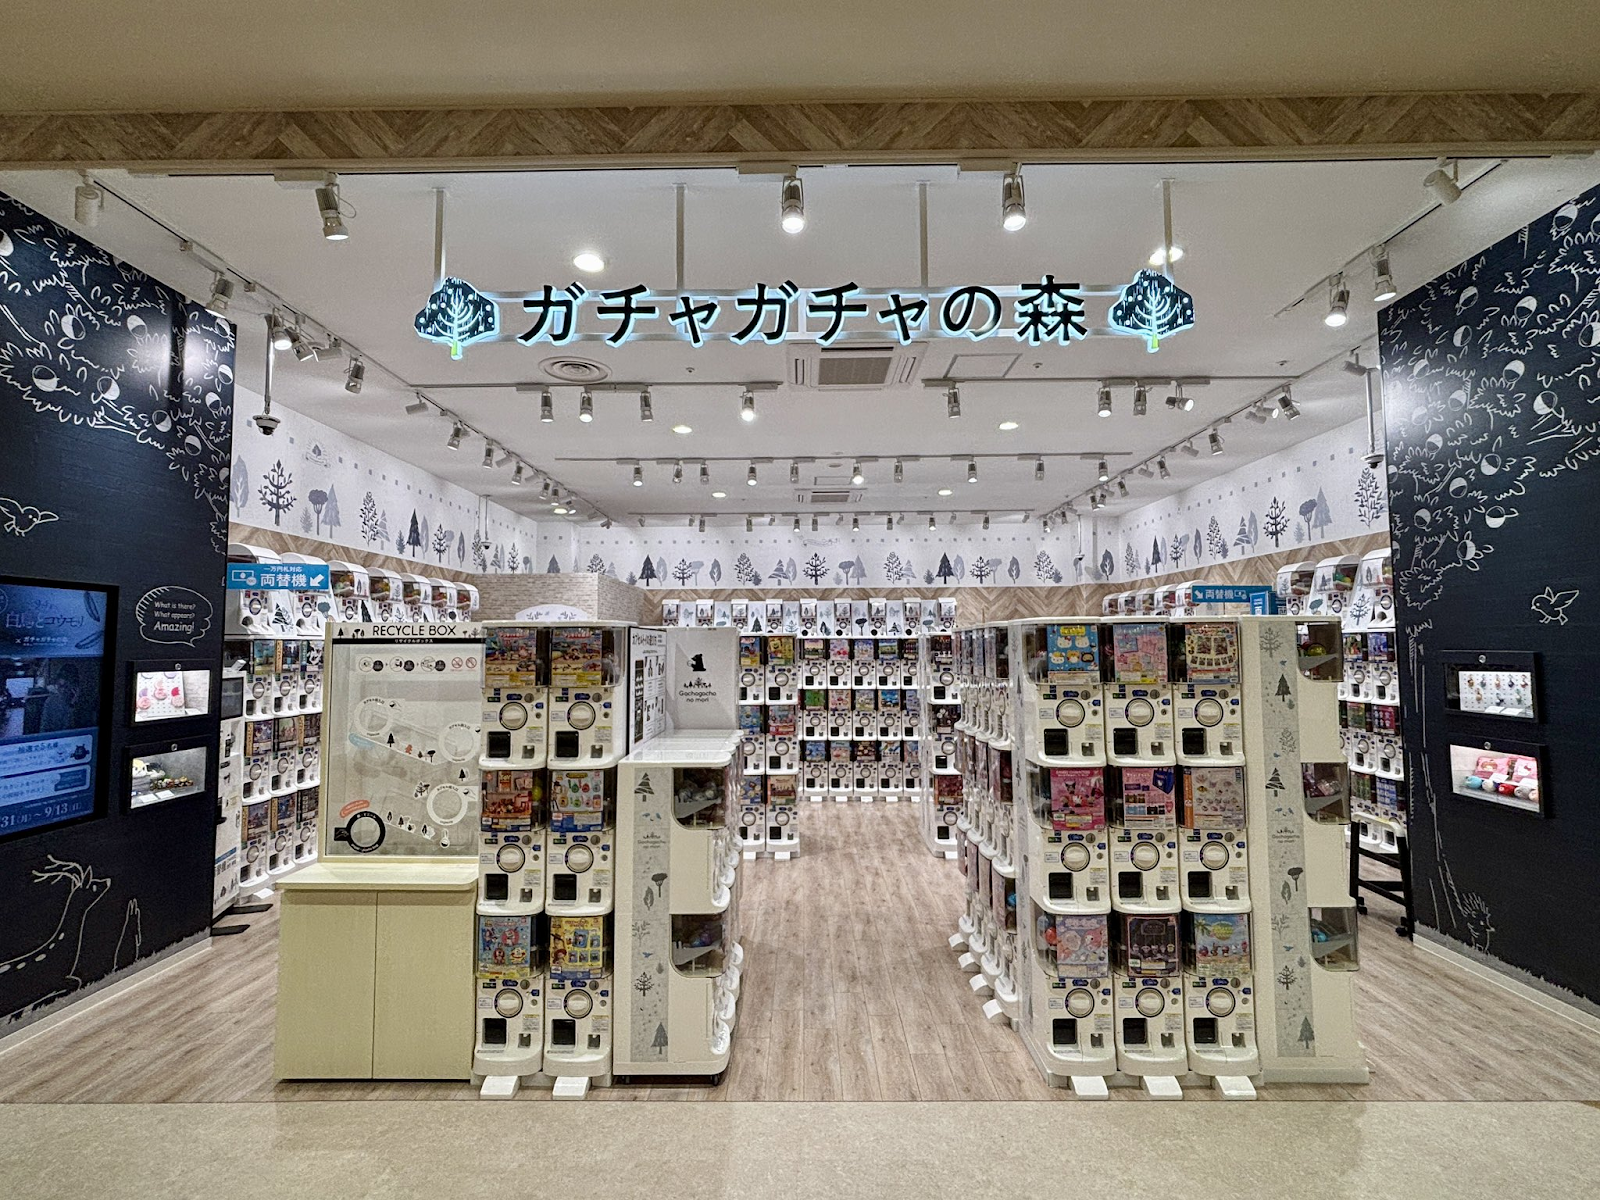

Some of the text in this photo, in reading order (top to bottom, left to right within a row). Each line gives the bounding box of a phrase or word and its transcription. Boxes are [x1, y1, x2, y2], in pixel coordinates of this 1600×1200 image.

[518, 275, 1089, 345] ガチャガチャの森
[260, 573, 307, 587] 両替機
[1205, 589, 1234, 600] 両替機
[154, 601, 171, 609] What
[171, 612, 196, 620] appears?
[153, 621, 195, 635] Amazing!
[372, 625, 457, 636] RECYCLE BOX
